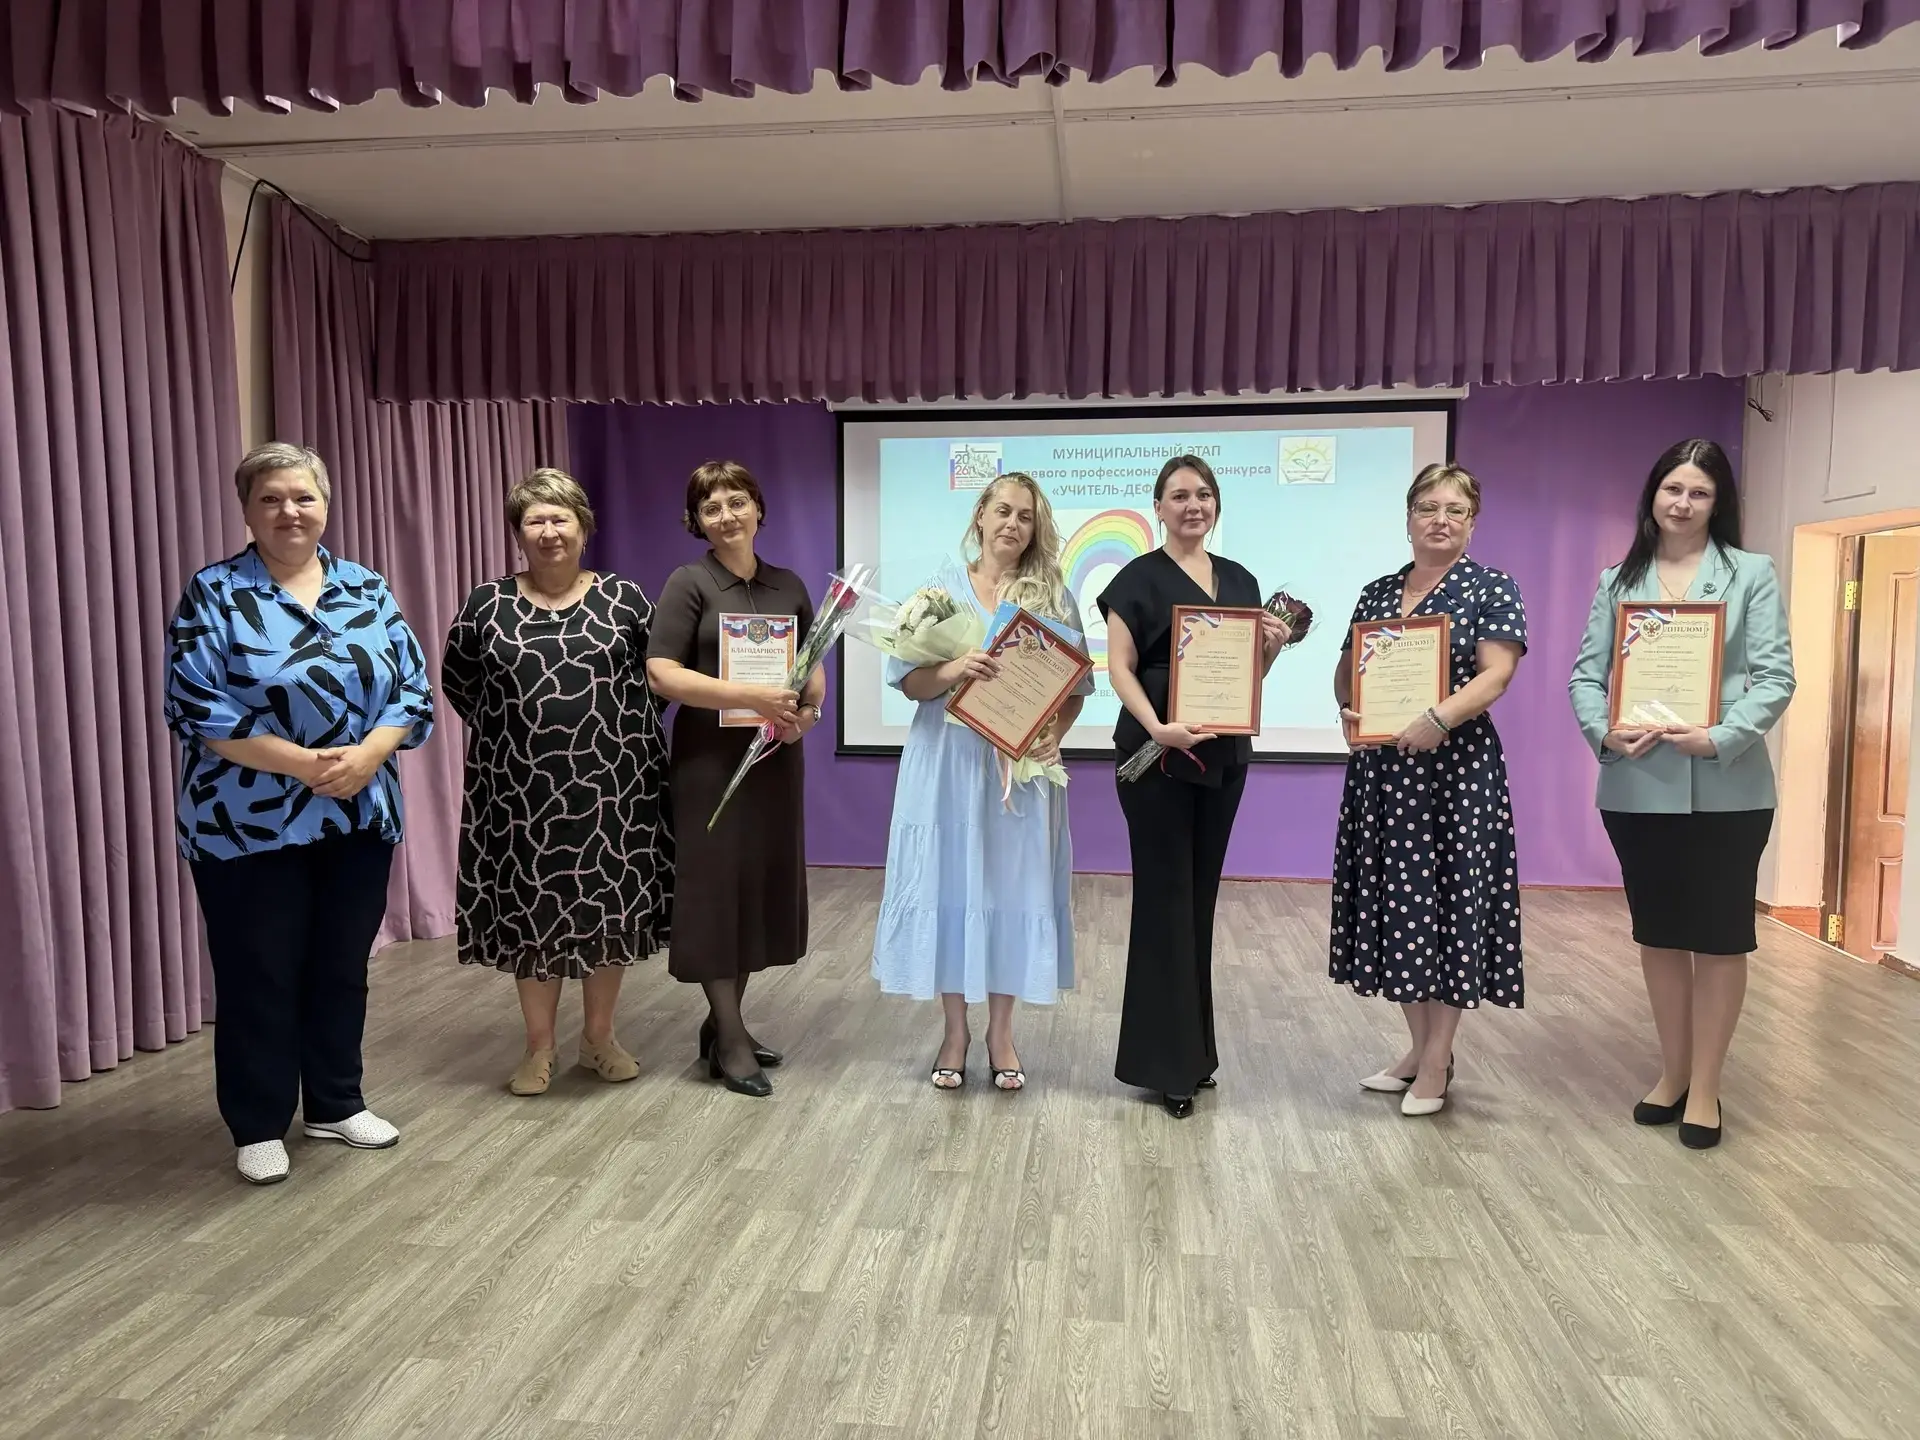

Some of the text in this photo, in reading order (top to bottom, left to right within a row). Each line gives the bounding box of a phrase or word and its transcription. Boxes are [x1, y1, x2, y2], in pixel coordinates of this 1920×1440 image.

[1053, 443, 1221, 460] МУНИЦИПАЛЬНЫЙ ЭТАП
[1071, 466, 1158, 480] профессиона
[1052, 483, 1156, 497] «УЧИТЕЛЬ-ДЕФ
